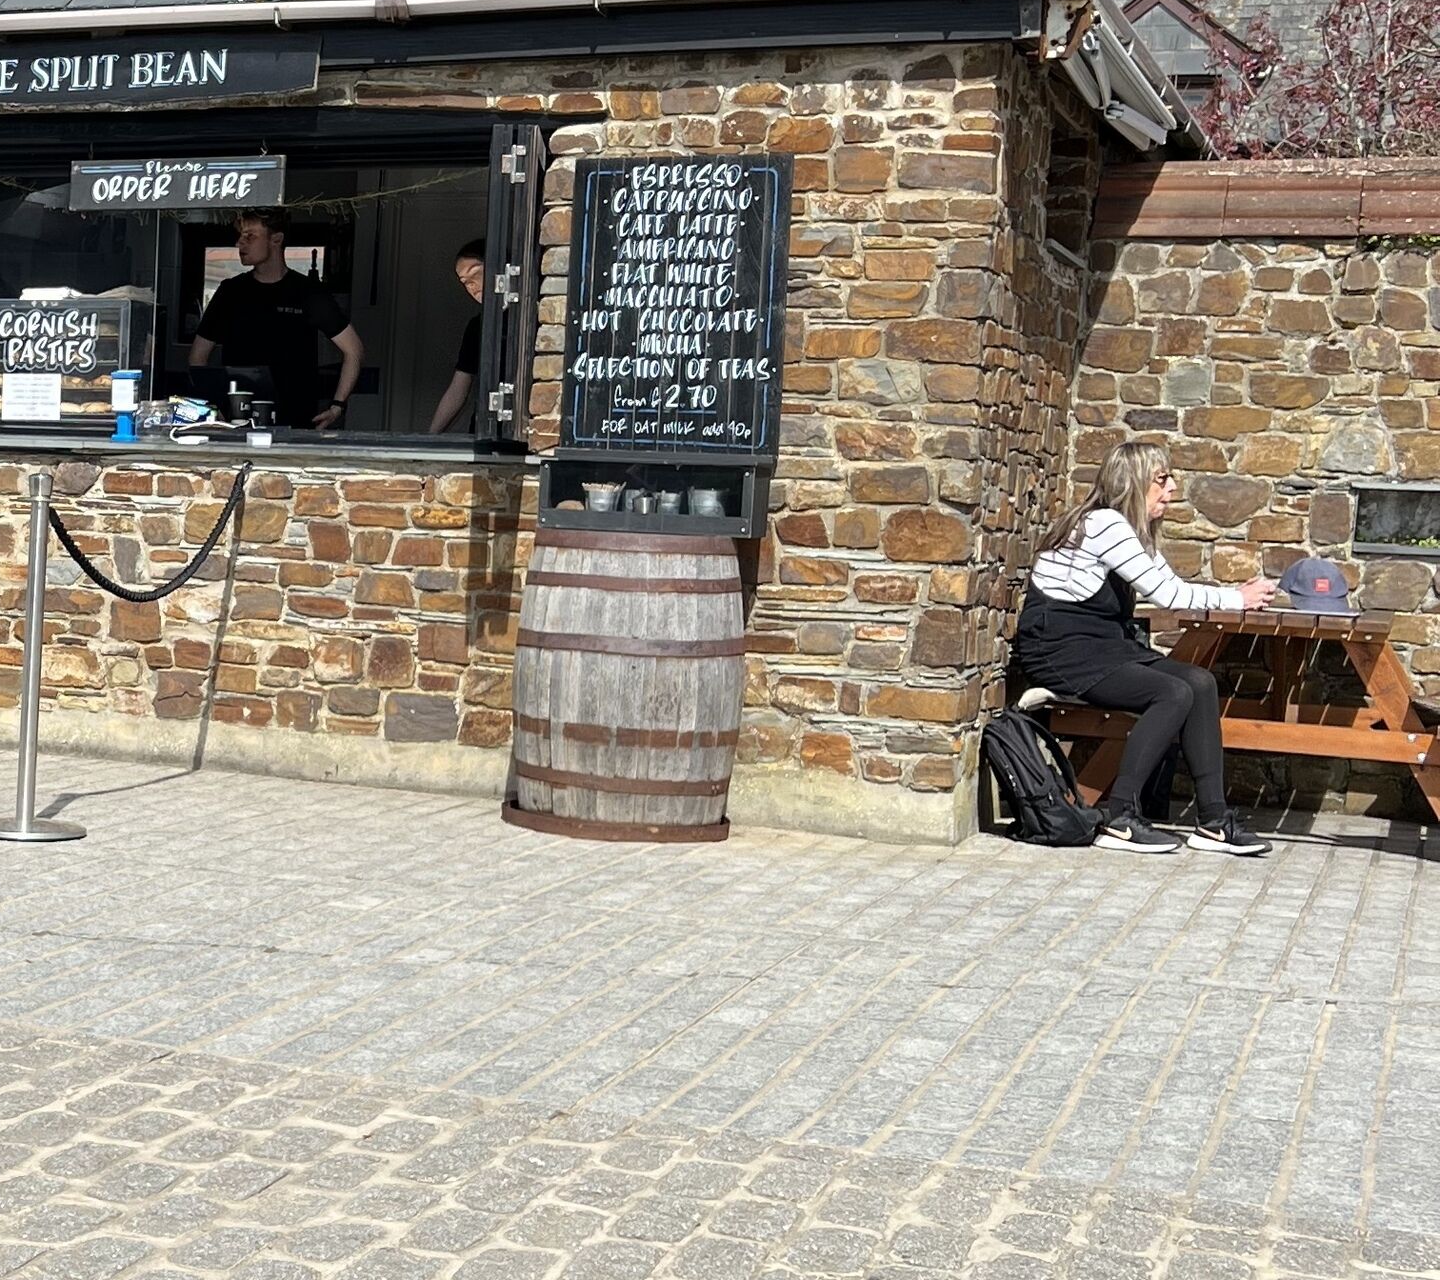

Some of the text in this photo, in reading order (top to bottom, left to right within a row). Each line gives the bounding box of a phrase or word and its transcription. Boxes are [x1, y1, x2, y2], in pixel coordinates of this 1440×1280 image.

[28, 53, 119, 93] SPLIT
[128, 48, 228, 89] BEAN
[145, 160, 205, 175] Please
[631, 163, 742, 189] ESPRESSO
[91, 172, 258, 203] ORDER HERE
[612, 187, 753, 214] CAPPUCCINO
[616, 213, 738, 237] CAFE LATTE
[619, 236, 735, 261] AMERICANO
[611, 262, 733, 286] FLAT WHITE
[604, 284, 734, 309] MACCHIATO
[580, 309, 758, 333] HOT CHOCOLATE
[9, 337, 95, 368] PASTIES
[640, 333, 702, 356] MOCHA
[573, 352, 771, 381] SELECTION OF TEAS
[614, 384, 647, 407] from
[601, 418, 752, 439] FOR OAT MILK add 40p
